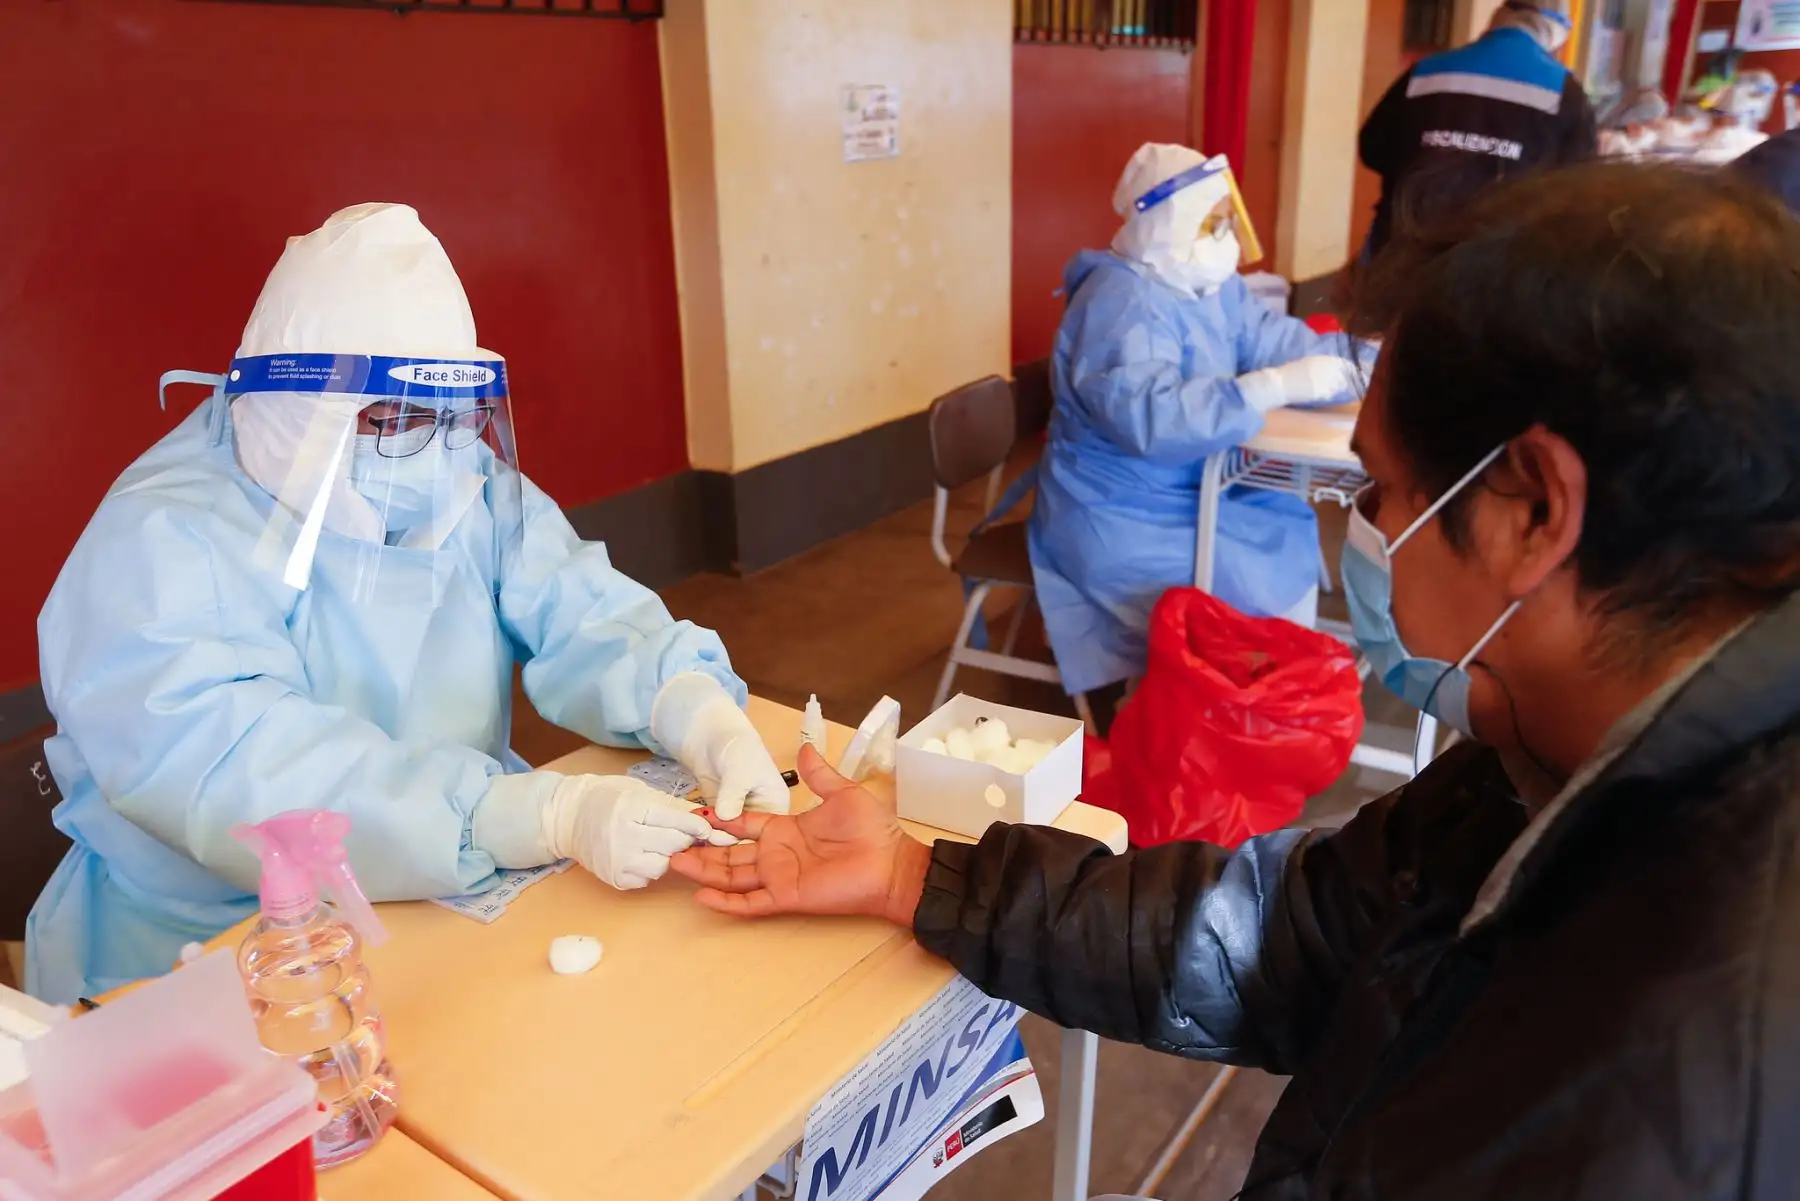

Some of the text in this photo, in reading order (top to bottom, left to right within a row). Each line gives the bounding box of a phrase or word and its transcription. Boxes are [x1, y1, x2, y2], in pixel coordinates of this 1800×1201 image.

[414, 367, 487, 382] Face Shield
[807, 1001, 1017, 1201] MINSA
